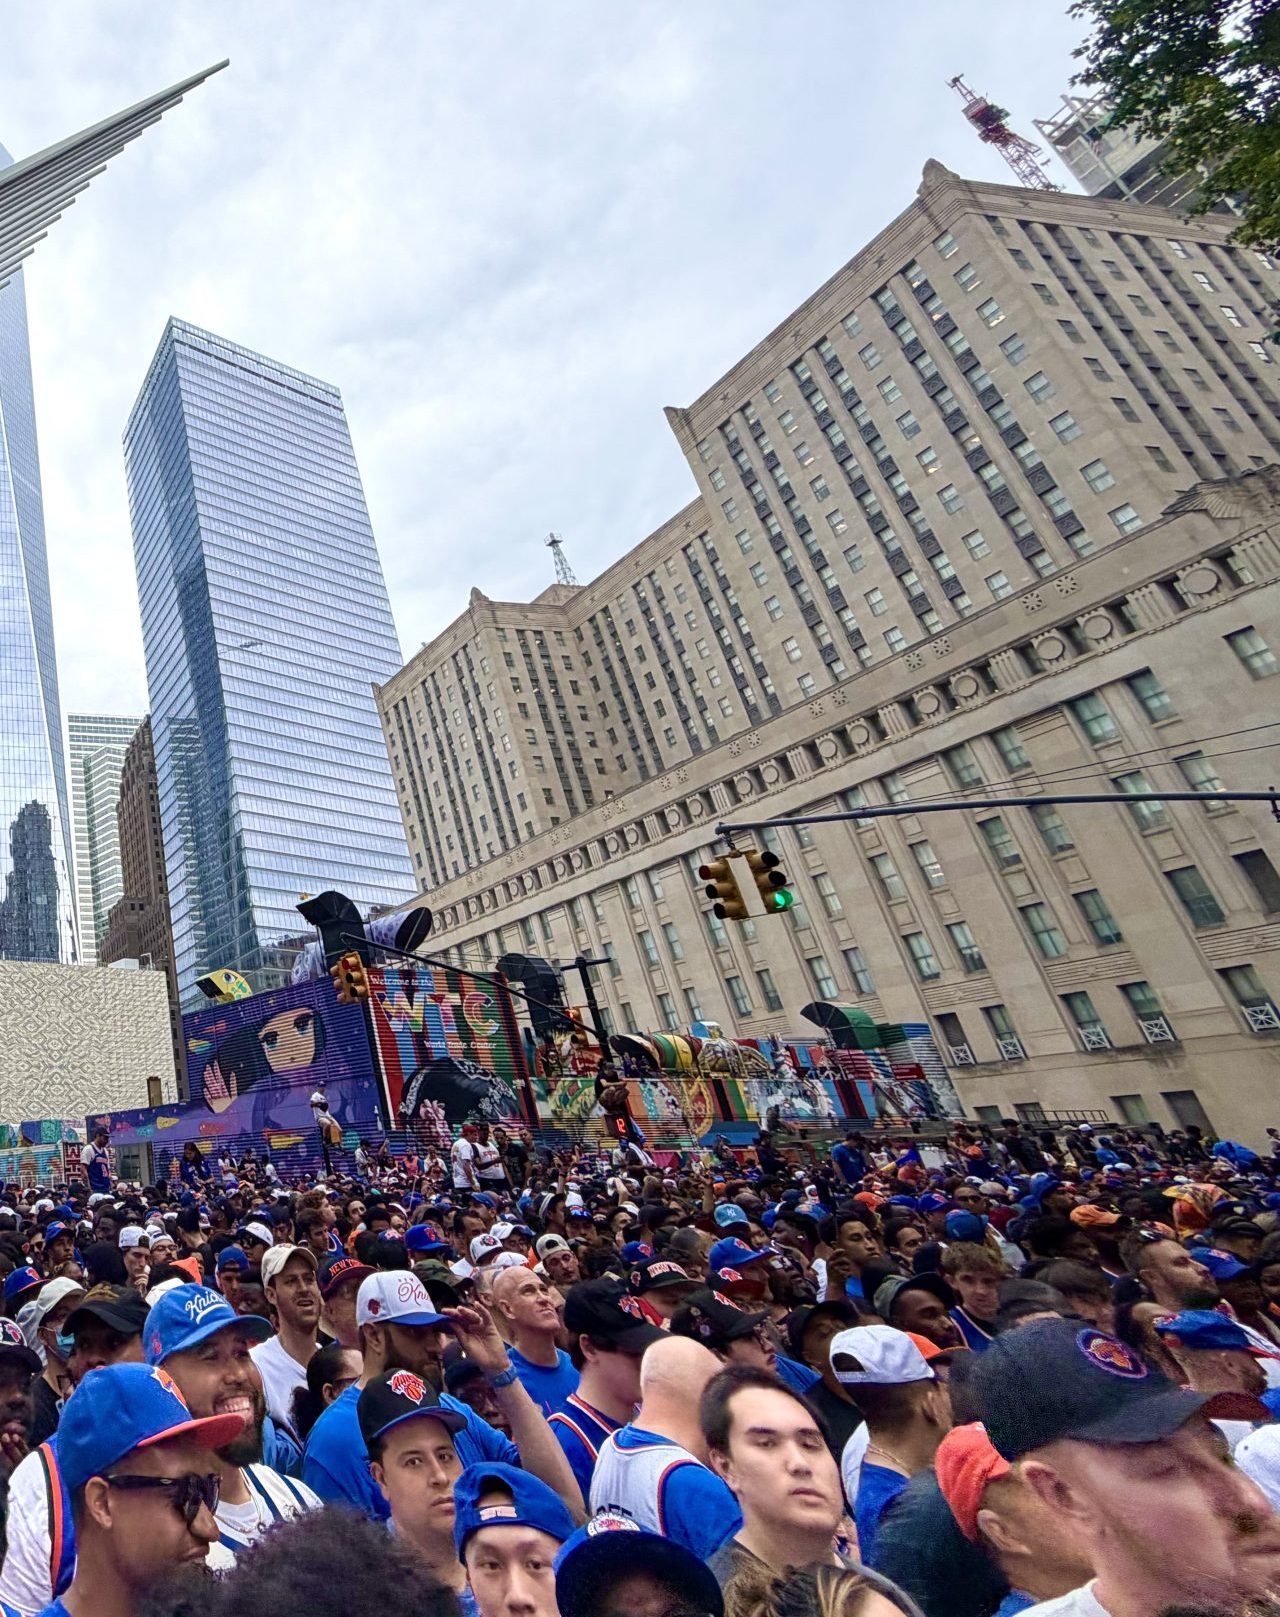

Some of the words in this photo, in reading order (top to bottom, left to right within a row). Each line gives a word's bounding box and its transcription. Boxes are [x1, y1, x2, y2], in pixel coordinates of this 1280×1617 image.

[370, 974, 410, 985] Welcome
[420, 978, 434, 986] the
[375, 991, 500, 1036] WTC
[424, 1040, 445, 1048] World
[470, 1041, 497, 1049] Center
[616, 1118, 626, 1133] 12
[328, 1258, 347, 1277] NEW
[398, 1282, 430, 1306] Kni
